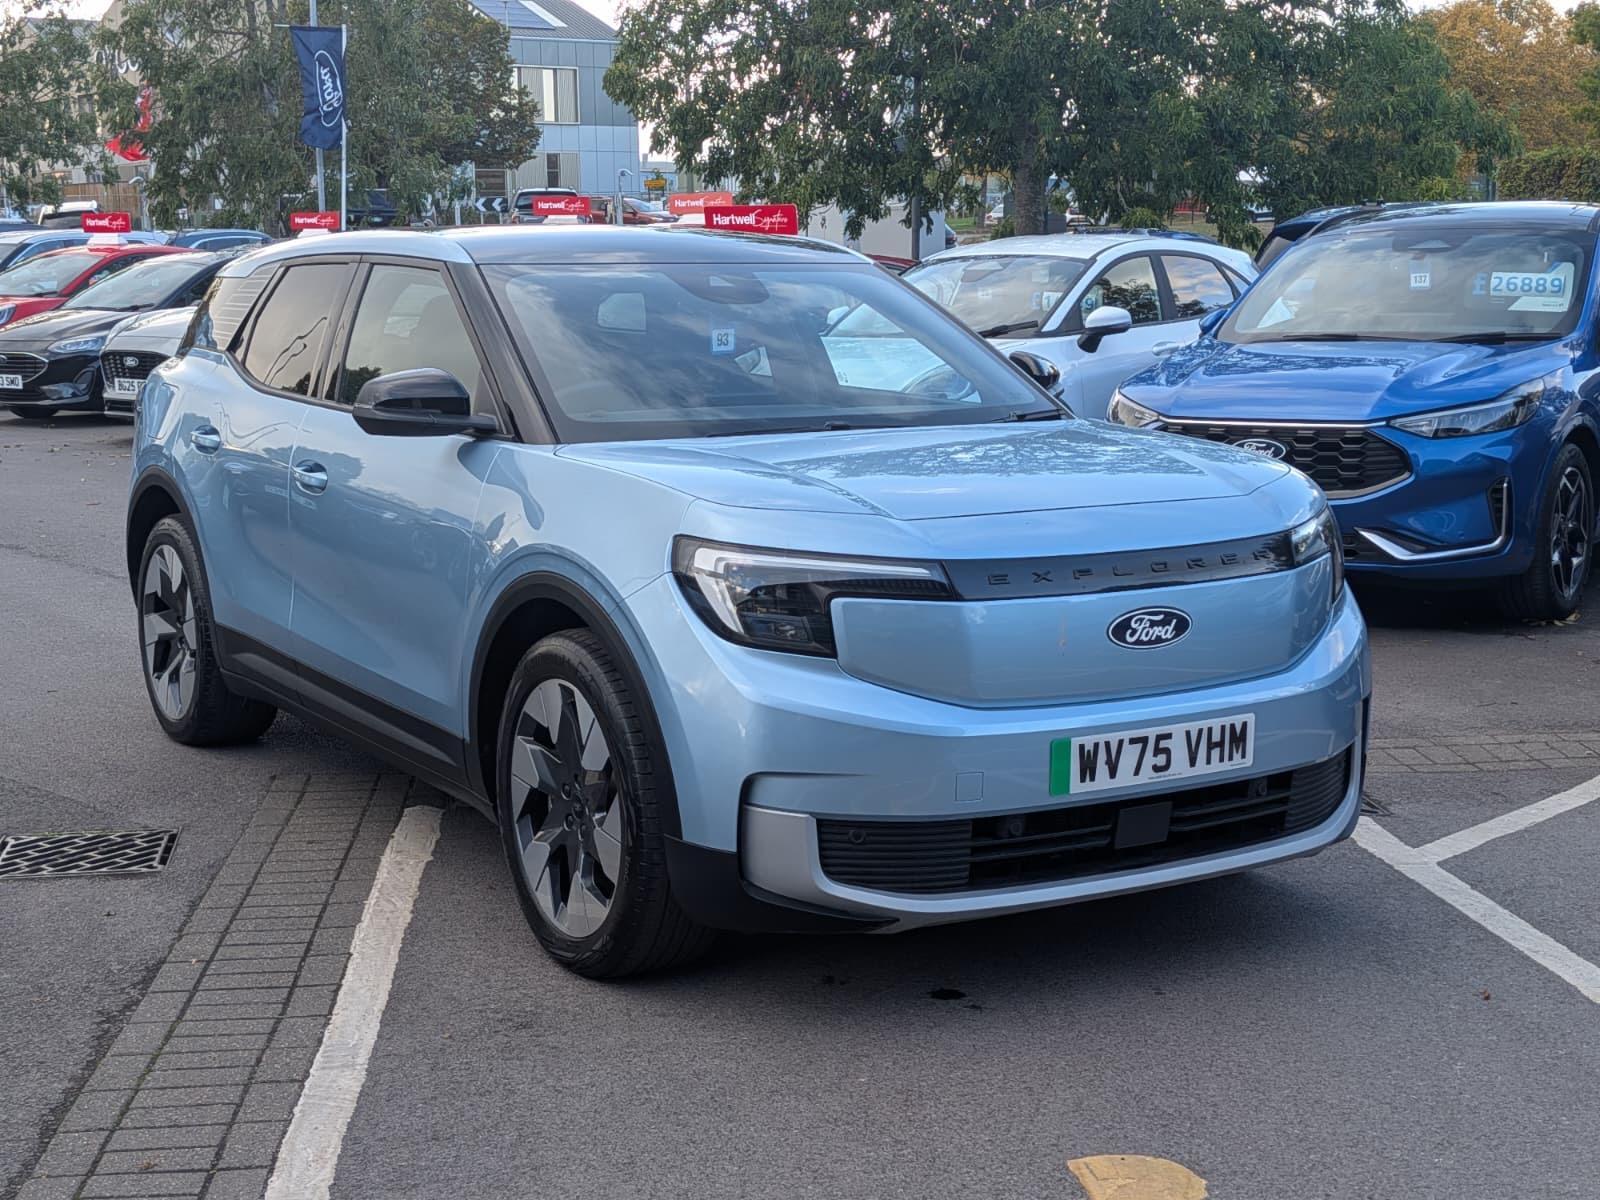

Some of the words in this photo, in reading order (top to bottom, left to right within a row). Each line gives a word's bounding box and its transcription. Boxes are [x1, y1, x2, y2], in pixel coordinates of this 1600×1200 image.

[537, 201, 565, 209] Hartwell
[674, 199, 704, 207] Hartwell
[712, 213, 755, 225] Hartwell
[1414, 274, 1428, 285] 137
[716, 332, 729, 347] 93
[986, 549, 1273, 586] EXPLORER
[1125, 613, 1177, 643] Ford
[1078, 732, 1174, 784] WV75
[1184, 720, 1249, 769] VHM
